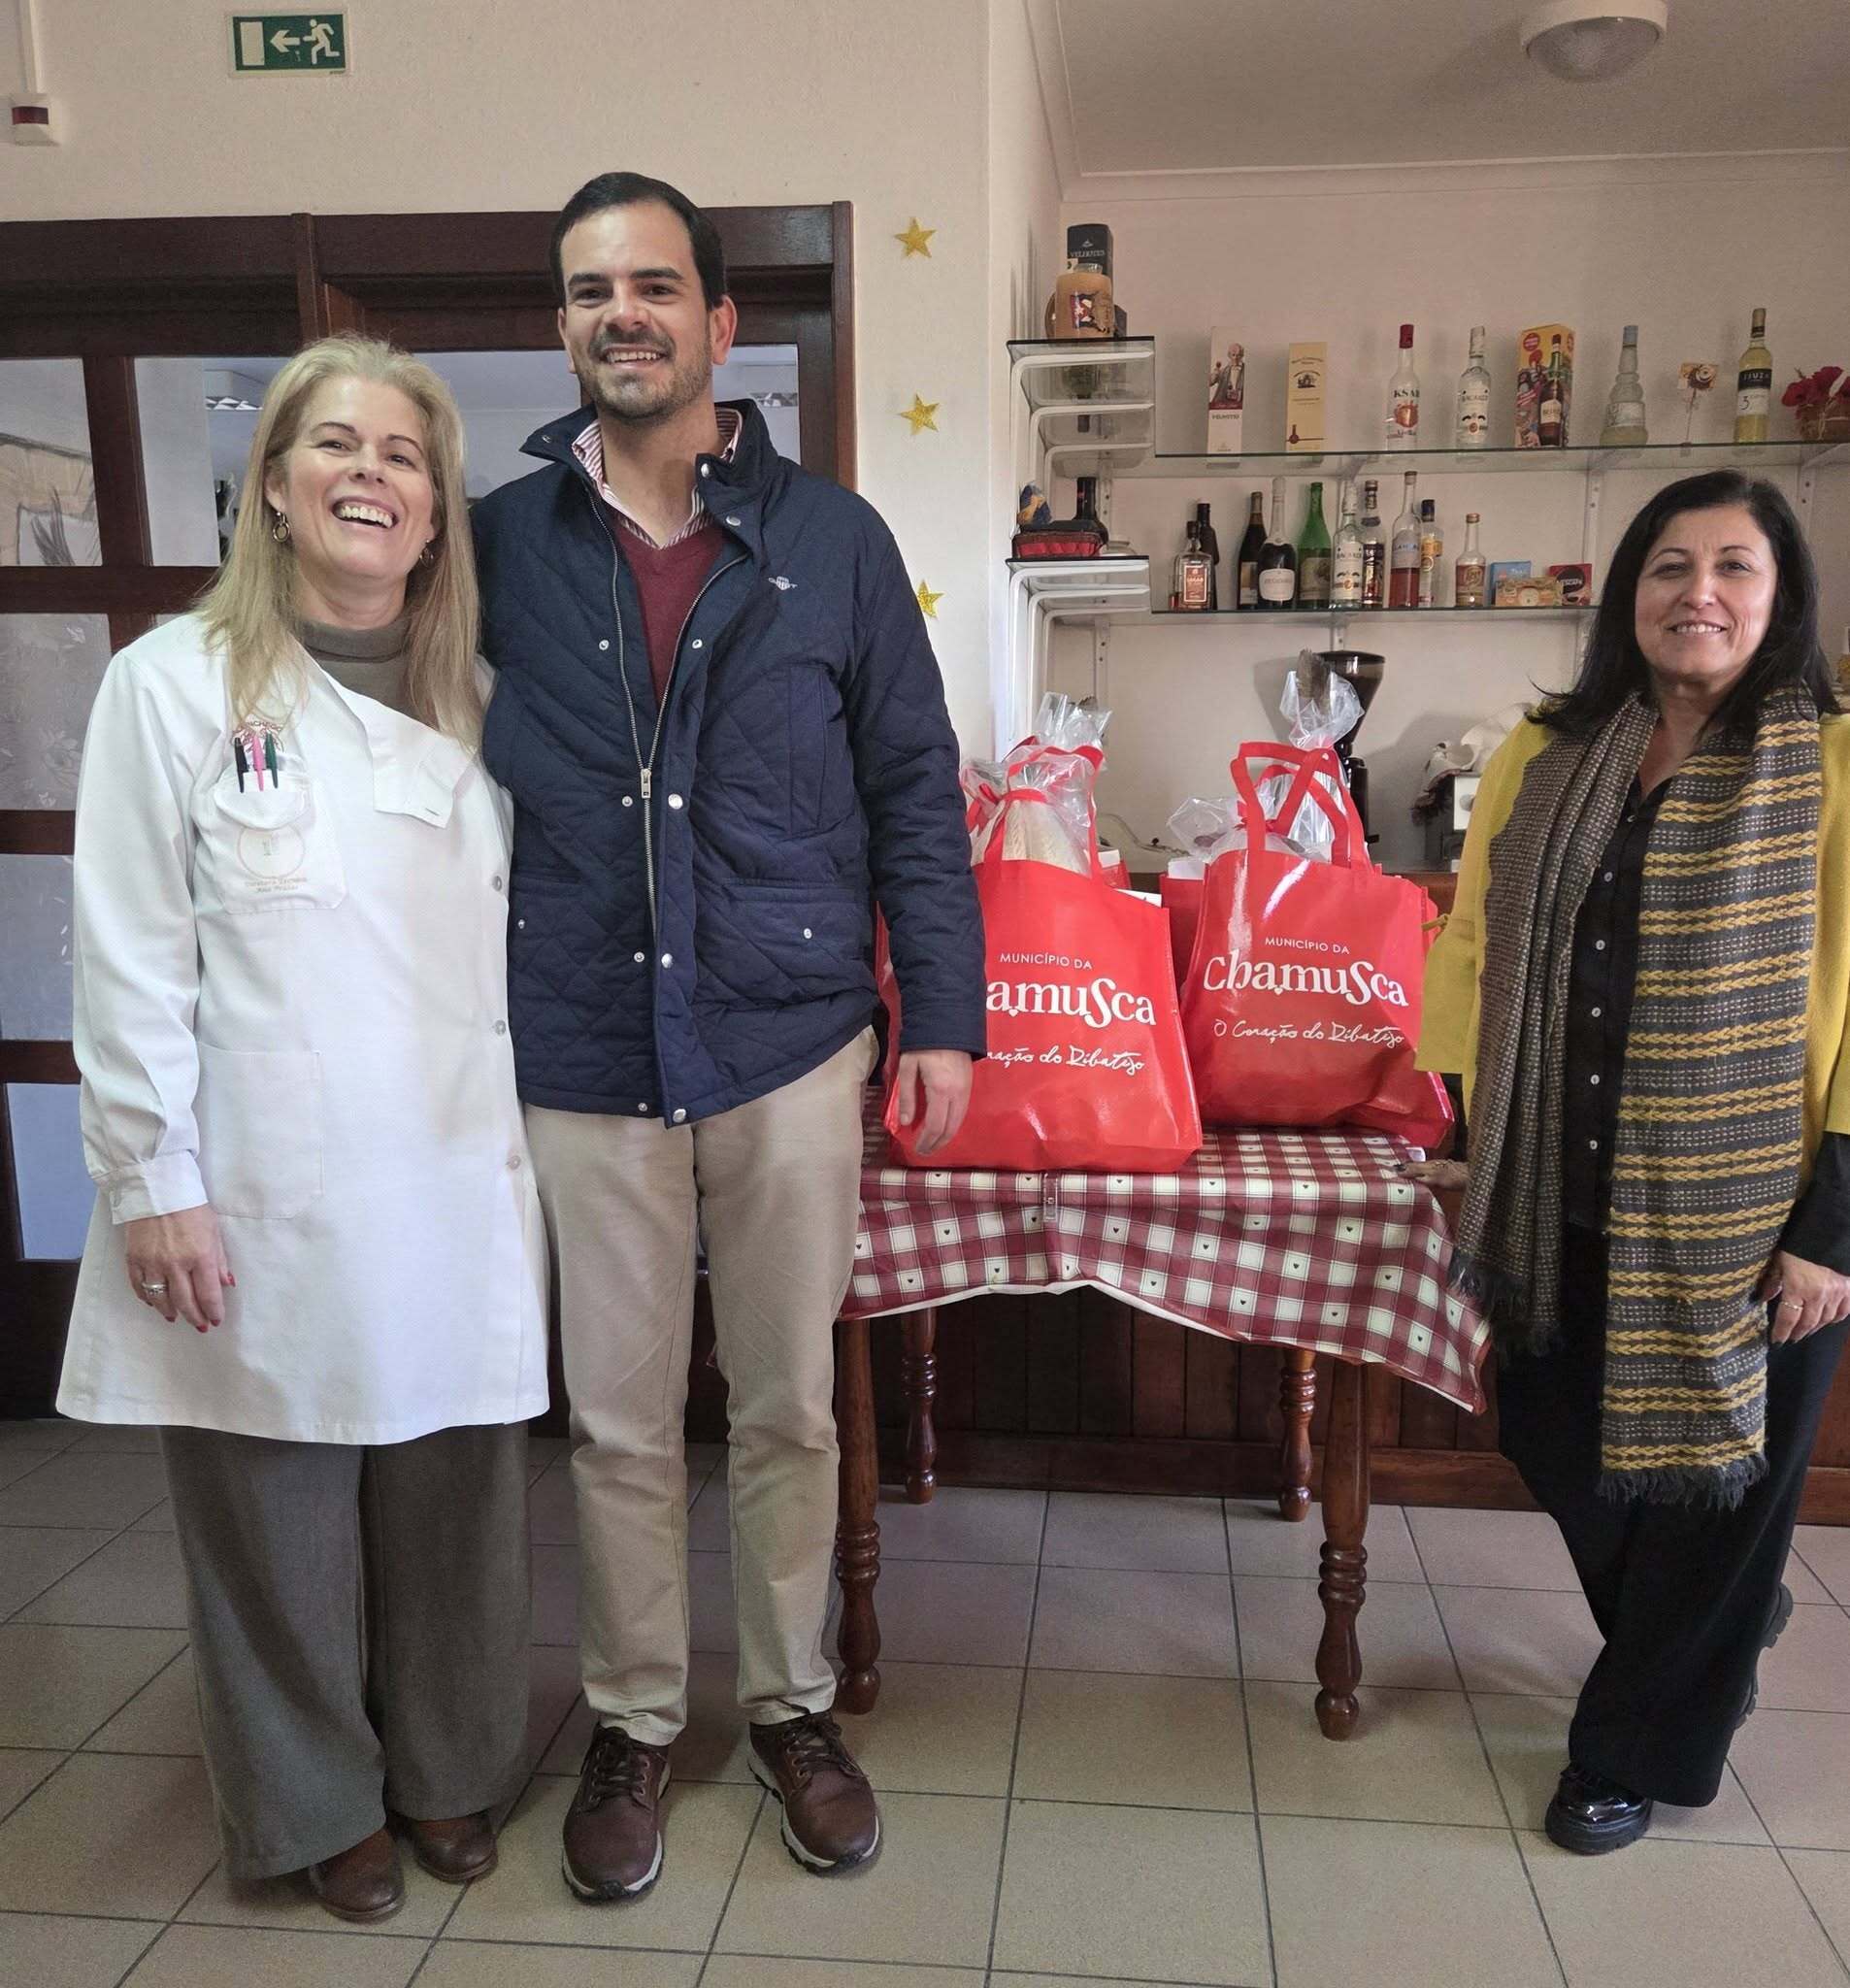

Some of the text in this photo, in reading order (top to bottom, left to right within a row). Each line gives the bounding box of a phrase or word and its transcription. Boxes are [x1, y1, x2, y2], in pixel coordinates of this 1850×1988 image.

[1265, 937, 1350, 954] MUNICÍPIO DA
[1000, 952, 1093, 970] MUNICÍPIO DA
[985, 977, 1157, 1029] amuSca
[1213, 1019, 1228, 1038] O
[1231, 1020, 1299, 1044] Coração
[1303, 1021, 1325, 1040] do
[986, 1047, 1035, 1068] ração
[1040, 1044, 1063, 1065] do
